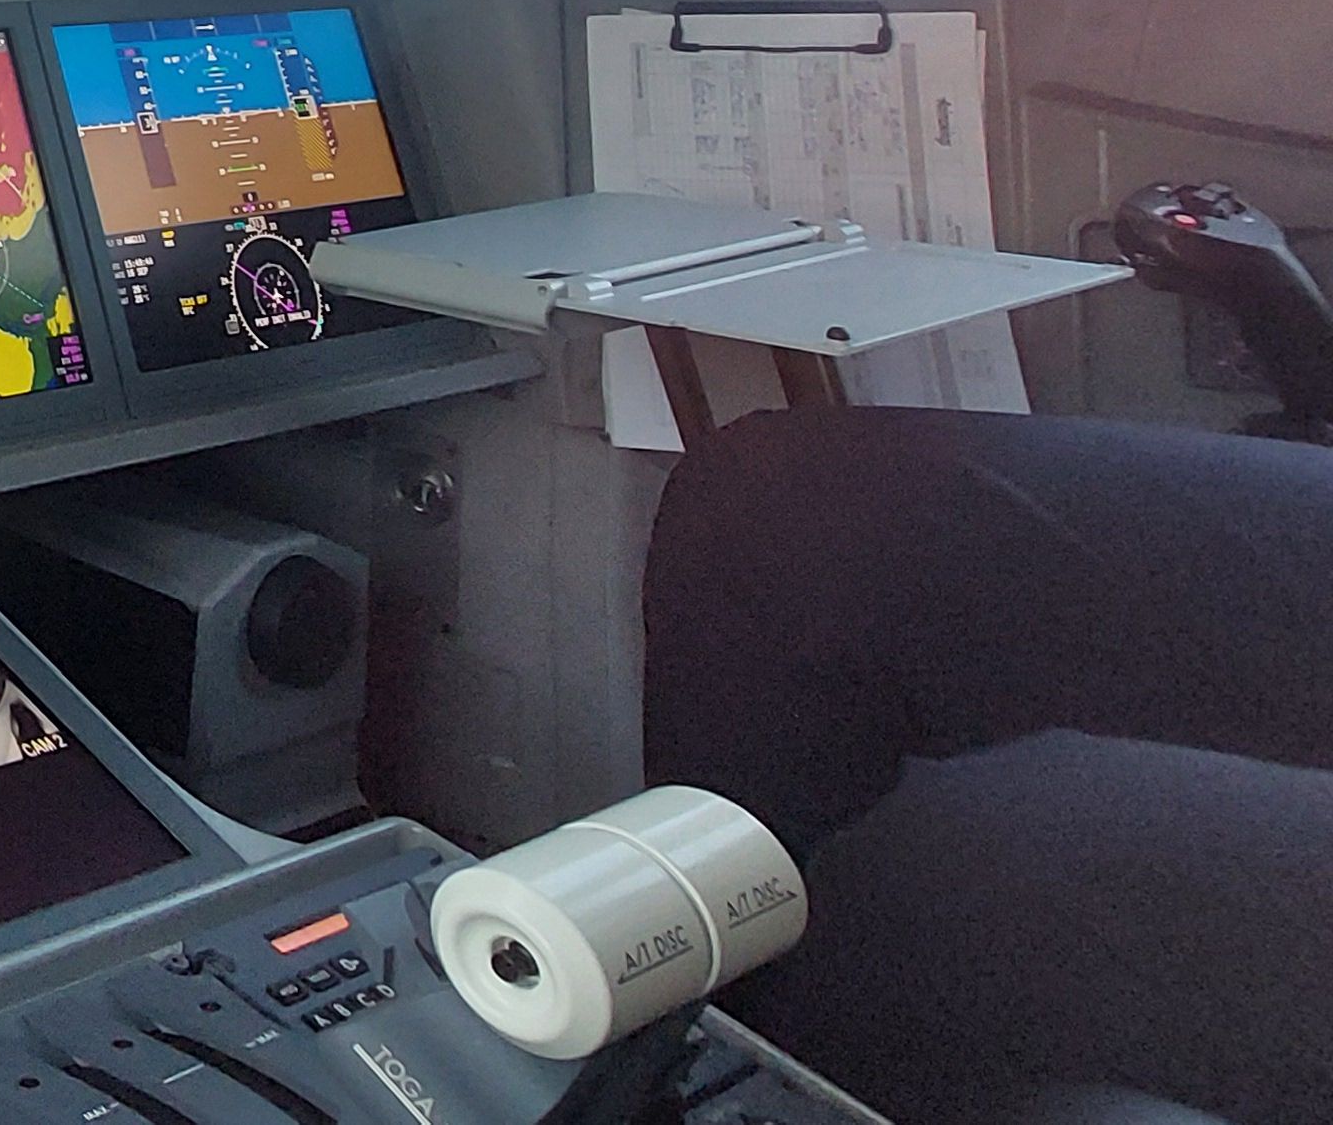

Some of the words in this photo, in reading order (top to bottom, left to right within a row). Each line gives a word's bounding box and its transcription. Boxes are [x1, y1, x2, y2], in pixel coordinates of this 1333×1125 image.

[21, 736, 57, 757] CAM
[52, 734, 68, 748] 2
[727, 891, 751, 919] A/T
[752, 877, 784, 907] DISC
[625, 942, 651, 971] A/T
[654, 925, 688, 957] DISC
[357, 993, 377, 1008] C
[376, 984, 395, 998] D
[313, 1014, 331, 1027] A
[373, 1043, 437, 1119] TOGA
